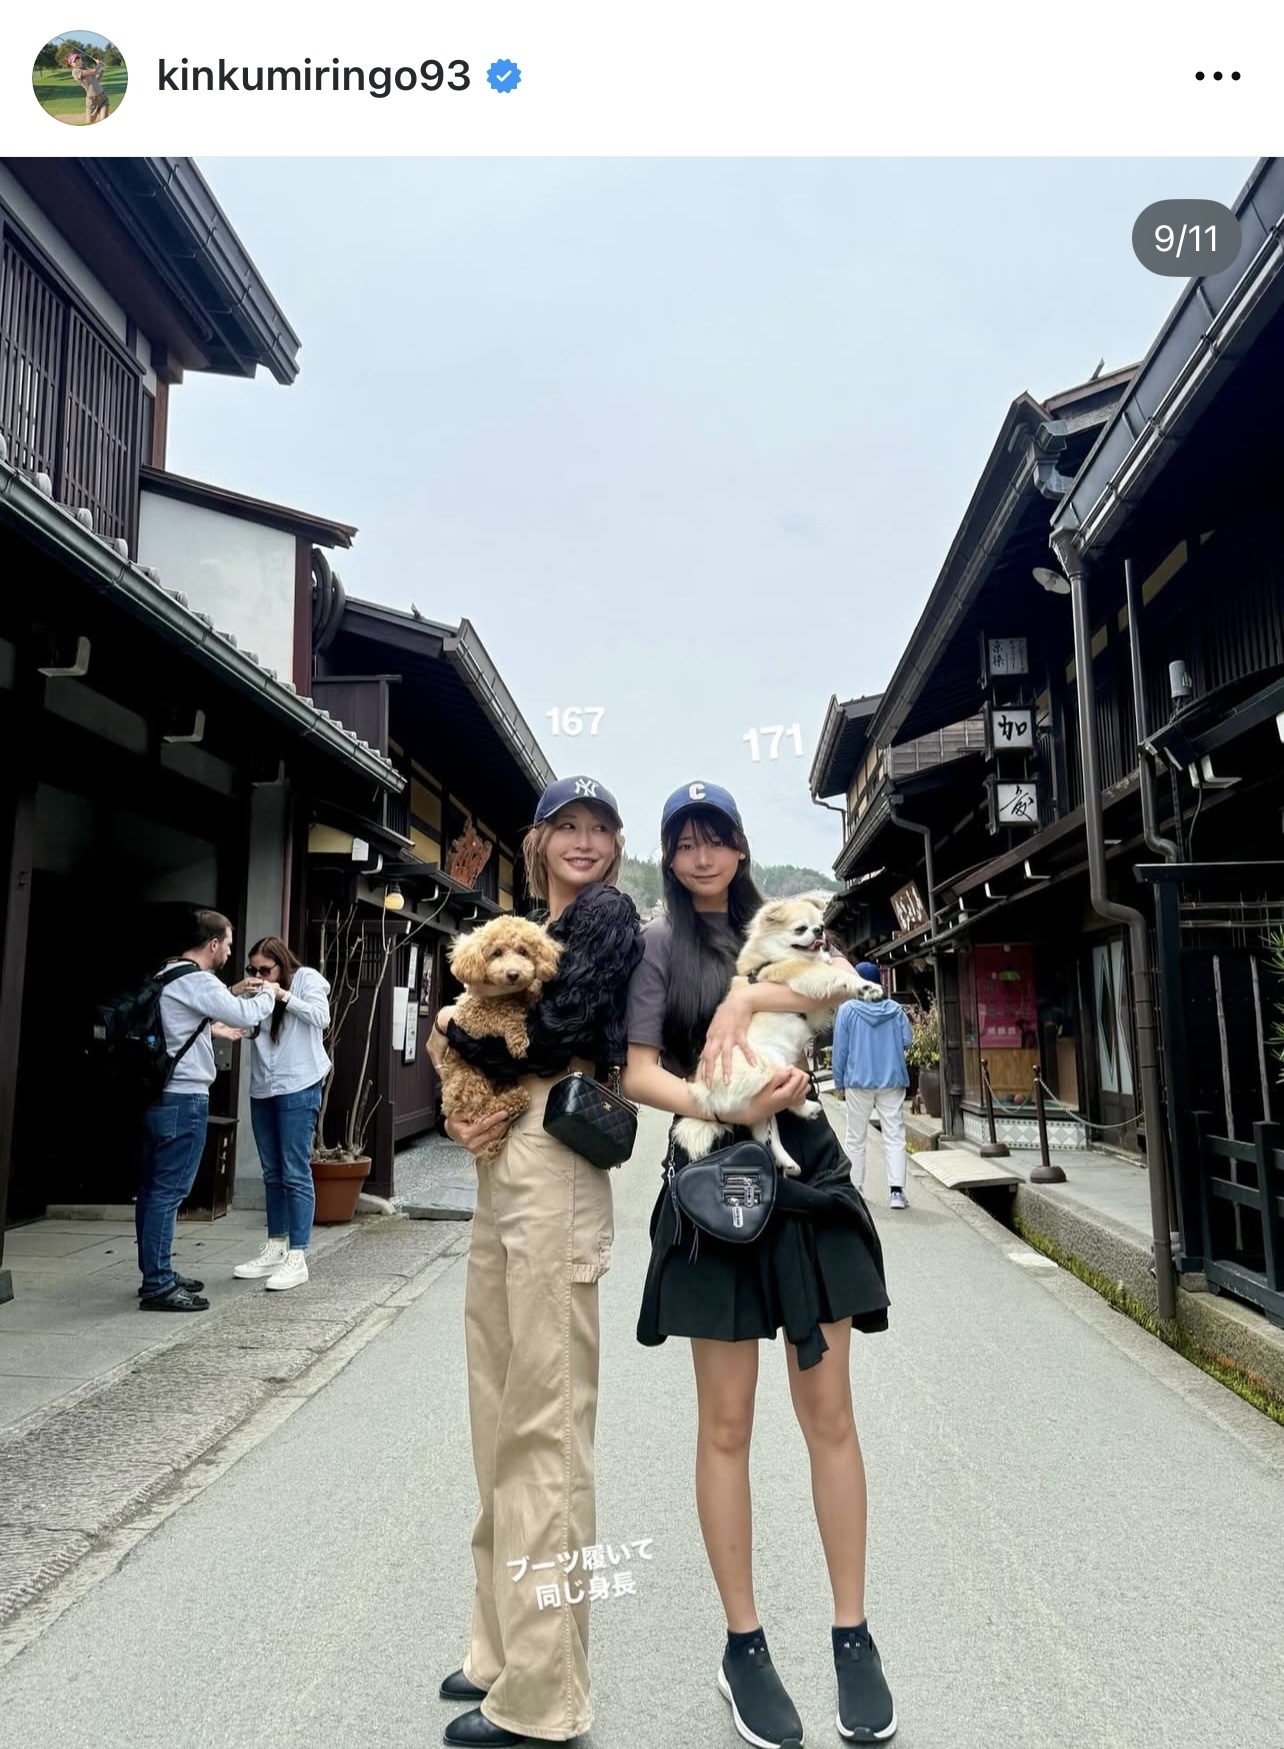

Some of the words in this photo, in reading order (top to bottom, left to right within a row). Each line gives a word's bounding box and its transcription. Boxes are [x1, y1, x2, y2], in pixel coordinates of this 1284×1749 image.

[998, 714, 1028, 741] 加
[574, 779, 598, 798] NY
[688, 784, 706, 800] C
